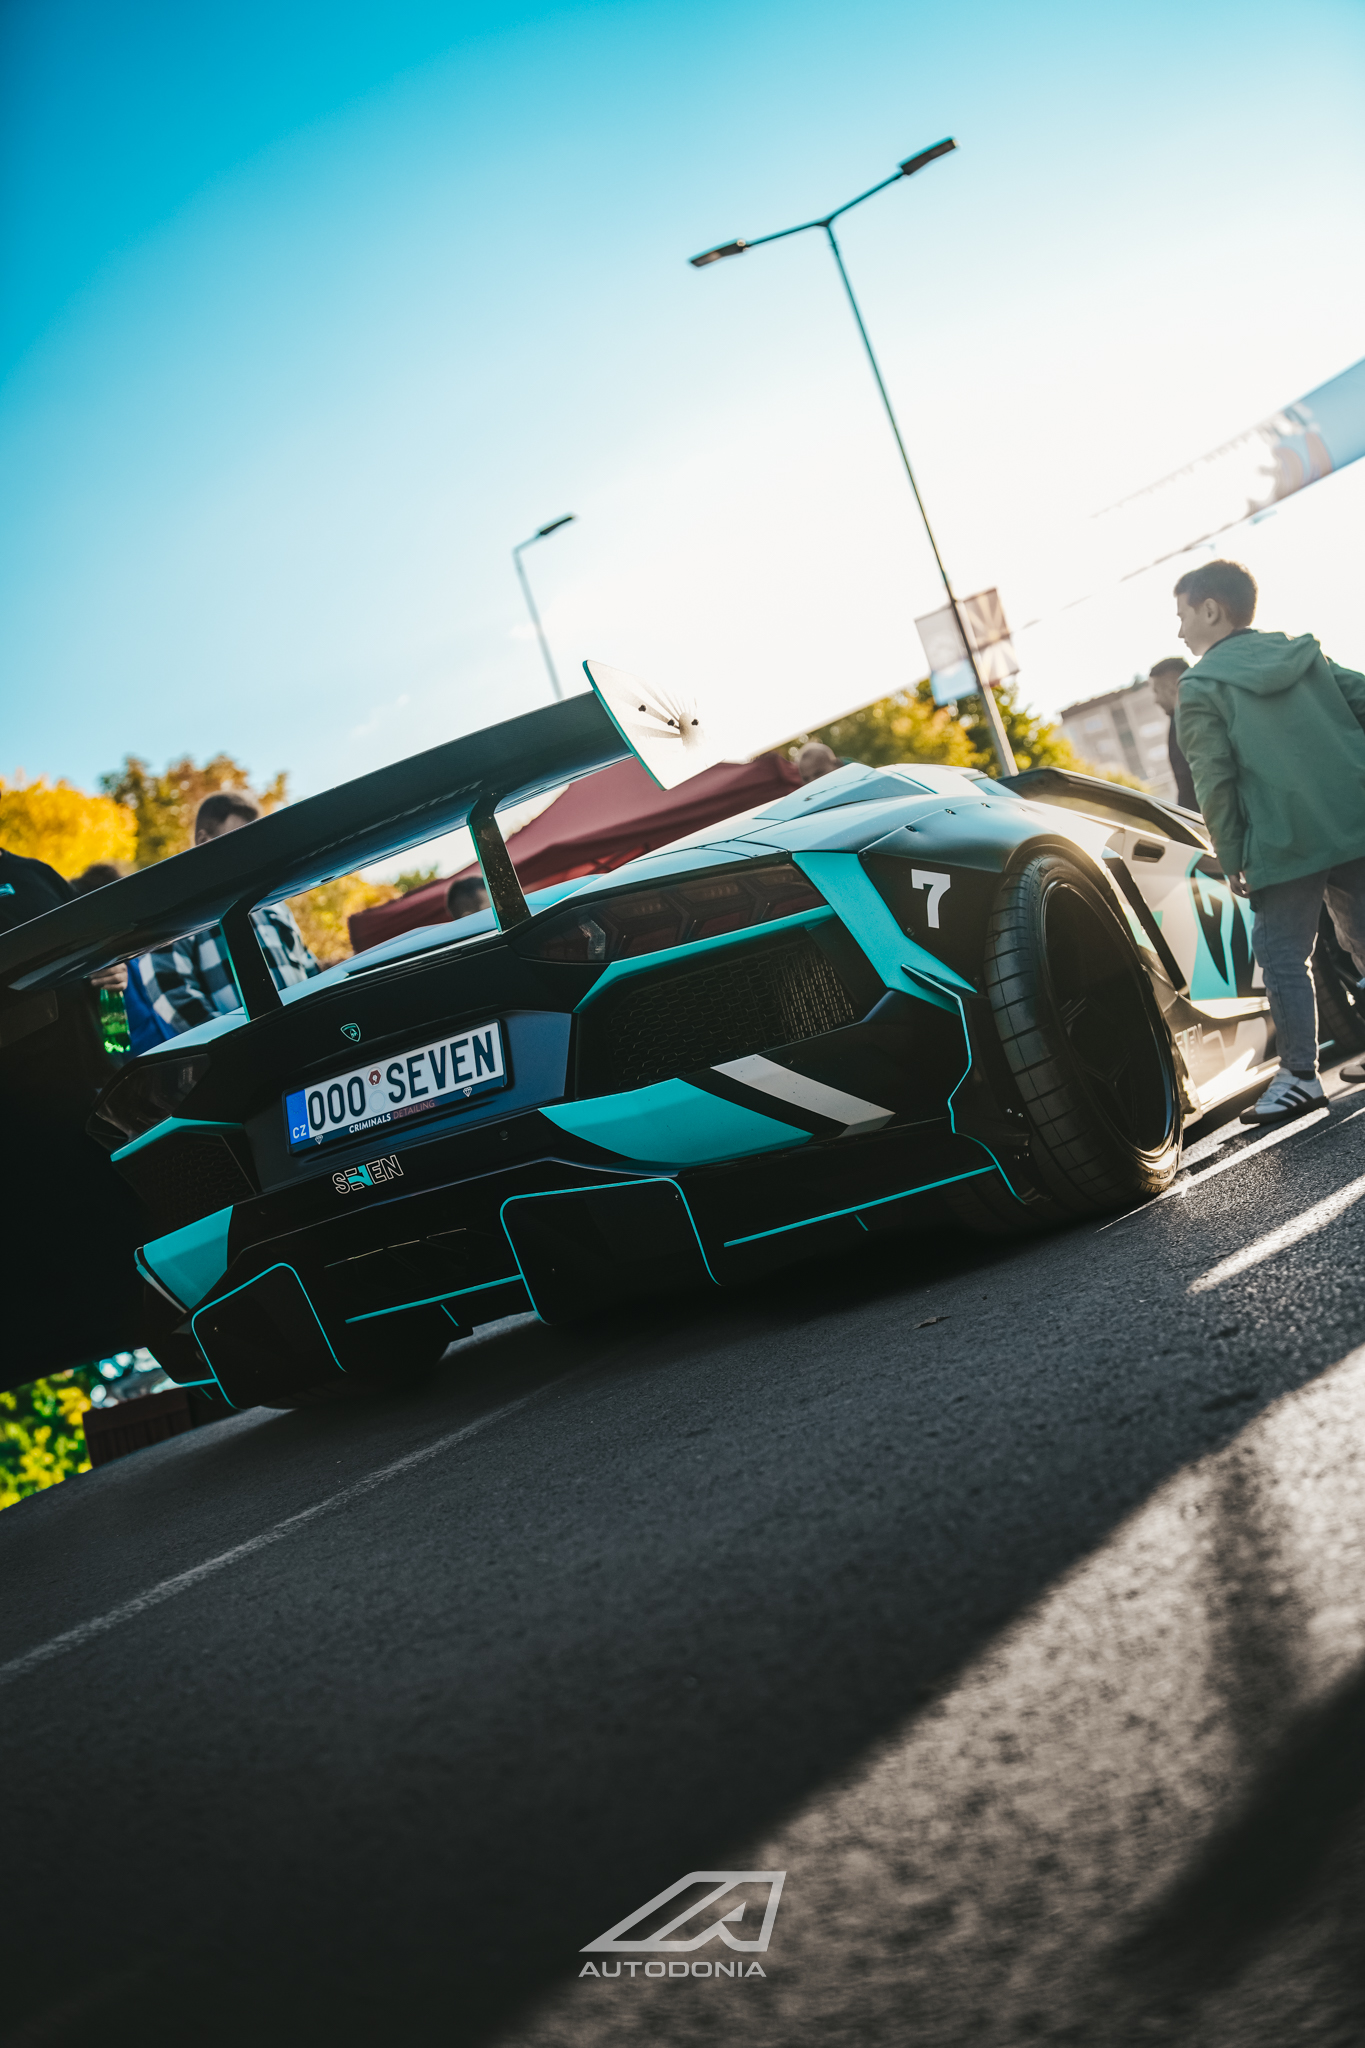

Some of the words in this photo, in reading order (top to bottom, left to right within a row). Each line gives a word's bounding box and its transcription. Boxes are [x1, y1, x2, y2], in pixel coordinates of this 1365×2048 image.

[911, 868, 951, 929] 7
[386, 1030, 496, 1103] SEVEN
[292, 1124, 307, 1139] CZ
[348, 1113, 392, 1134] CRIMINALS
[393, 1099, 436, 1120] DETAILING
